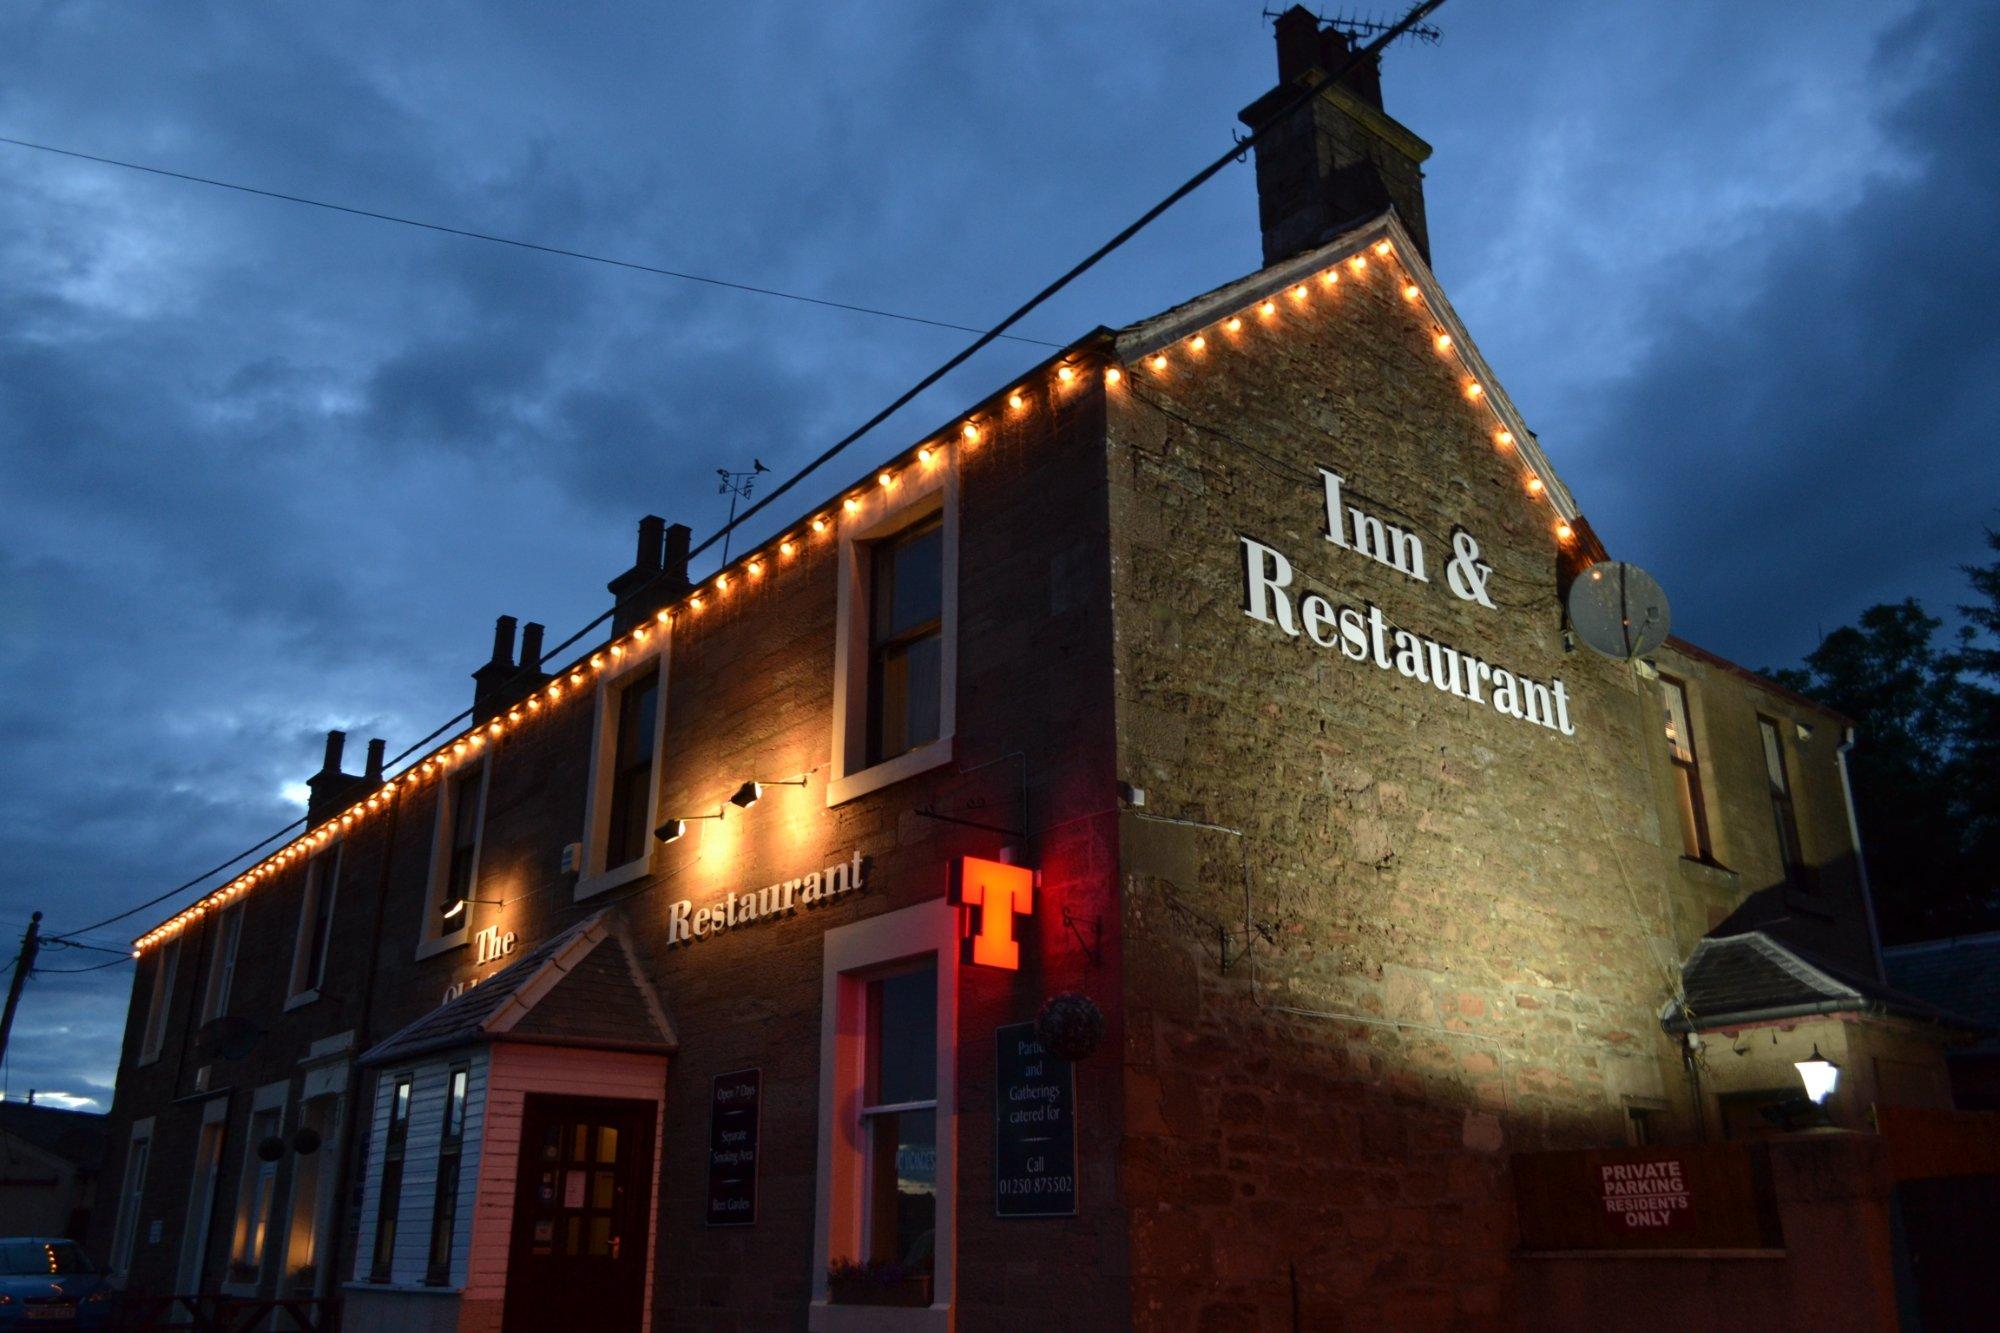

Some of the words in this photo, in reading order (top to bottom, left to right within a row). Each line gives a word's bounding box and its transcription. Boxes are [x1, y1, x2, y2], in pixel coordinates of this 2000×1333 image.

[1318, 467, 1429, 583] Inn
[1446, 531, 1497, 610] &
[1240, 536, 1575, 736] Restaurant
[666, 850, 864, 945] Restaurant
[475, 924, 516, 965] The
[1025, 1060, 1042, 1077] and
[1009, 1084, 1060, 1103] Gatherings
[1010, 1105, 1044, 1123] catered
[1047, 1104, 1060, 1120] for
[1026, 1156, 1044, 1173] Call
[1602, 1161, 1682, 1180] PRIVATE
[1000, 1178, 1031, 1194] 01250
[1604, 1178, 1684, 1195] PARKING
[1606, 1196, 1688, 1212] RESIDENTS
[1625, 1210, 1670, 1227] ONLY
